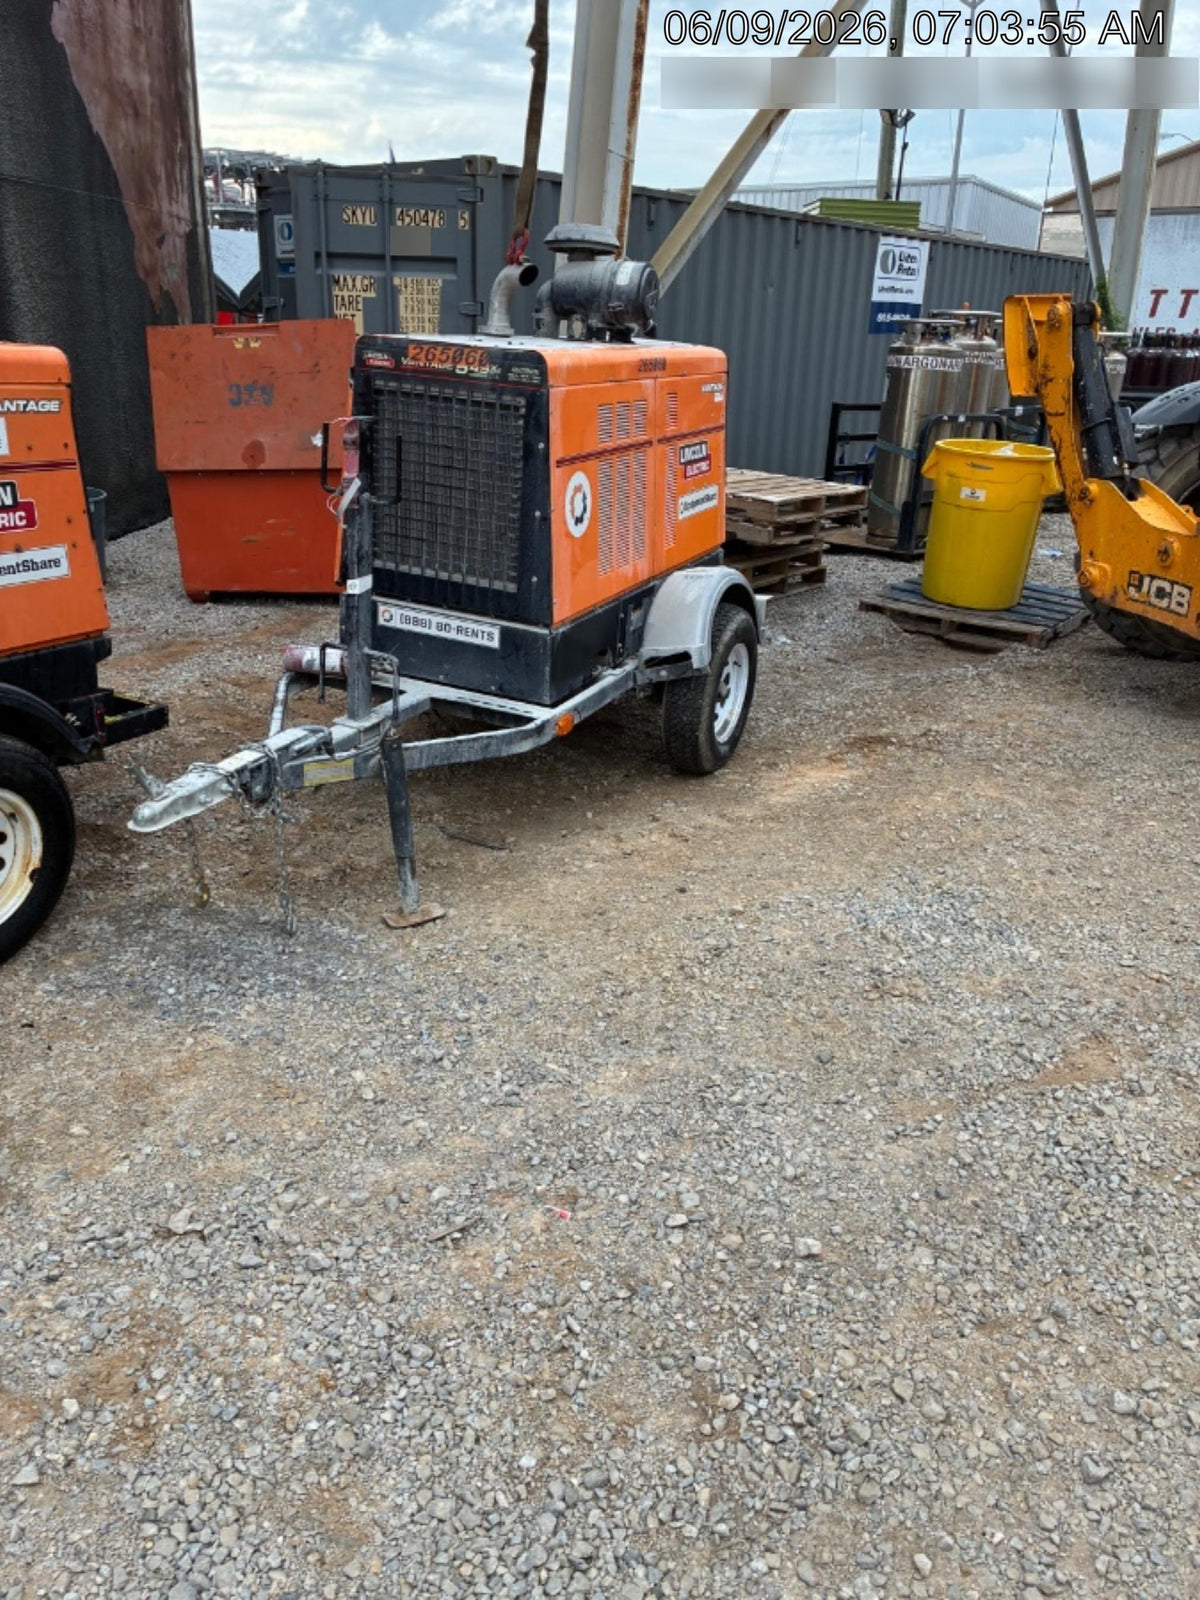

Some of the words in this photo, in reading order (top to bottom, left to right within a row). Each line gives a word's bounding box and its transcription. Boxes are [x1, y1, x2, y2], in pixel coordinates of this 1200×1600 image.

[342, 205, 378, 225] SKYU
[397, 207, 445, 228] 450478
[459, 210, 469, 229] 5
[332, 274, 377, 293] MAX.GR
[334, 295, 362, 312] TARE
[411, 344, 490, 367] 265060
[903, 356, 947, 370] ARGON
[0, 400, 61, 412] NTAGE
[1127, 574, 1191, 616] JCB
